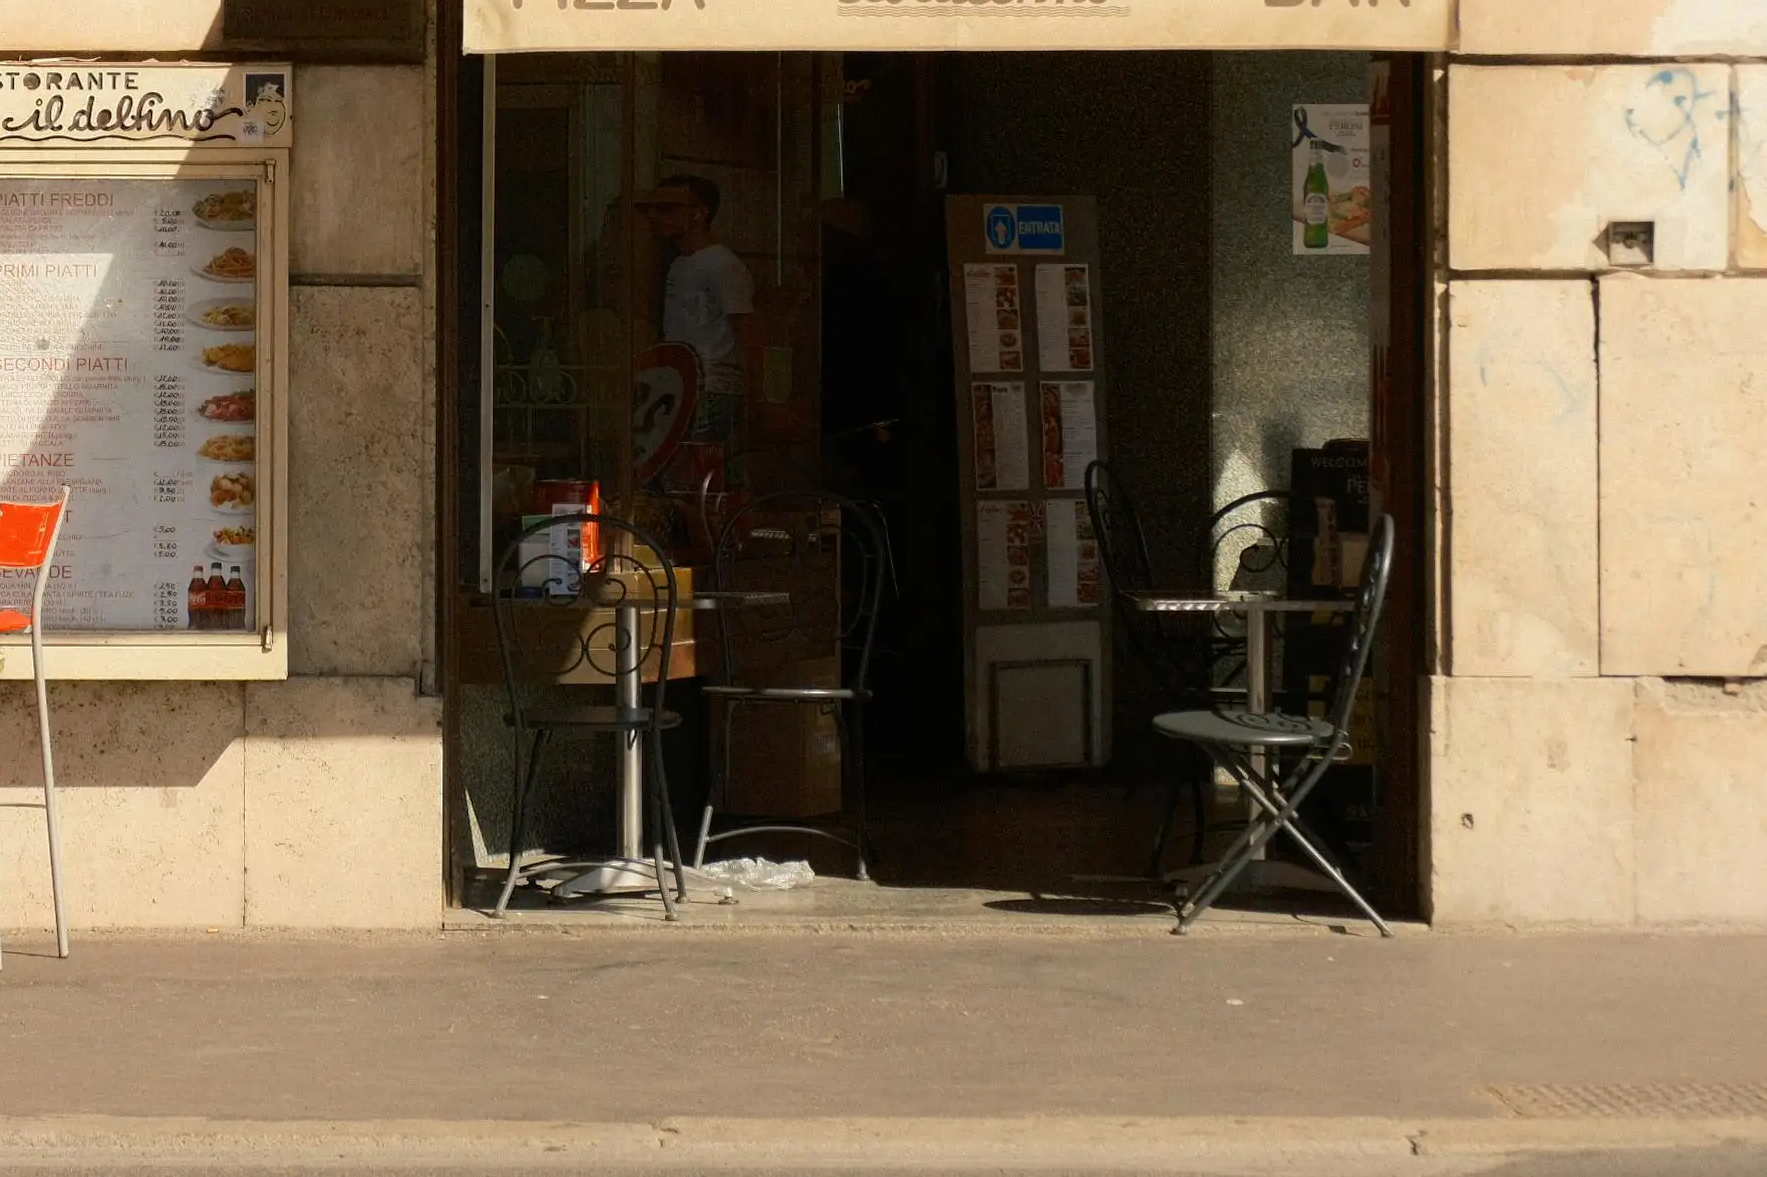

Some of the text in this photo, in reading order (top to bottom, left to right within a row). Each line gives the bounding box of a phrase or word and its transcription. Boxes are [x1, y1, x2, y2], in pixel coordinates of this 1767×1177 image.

[2, 94, 63, 131] il
[68, 92, 243, 131] delfino
[51, 193, 113, 206] FREDDI
[1018, 222, 1061, 235] ENTRATA
[46, 264, 97, 277] PIATTI
[77, 358, 128, 371] PIATTI
